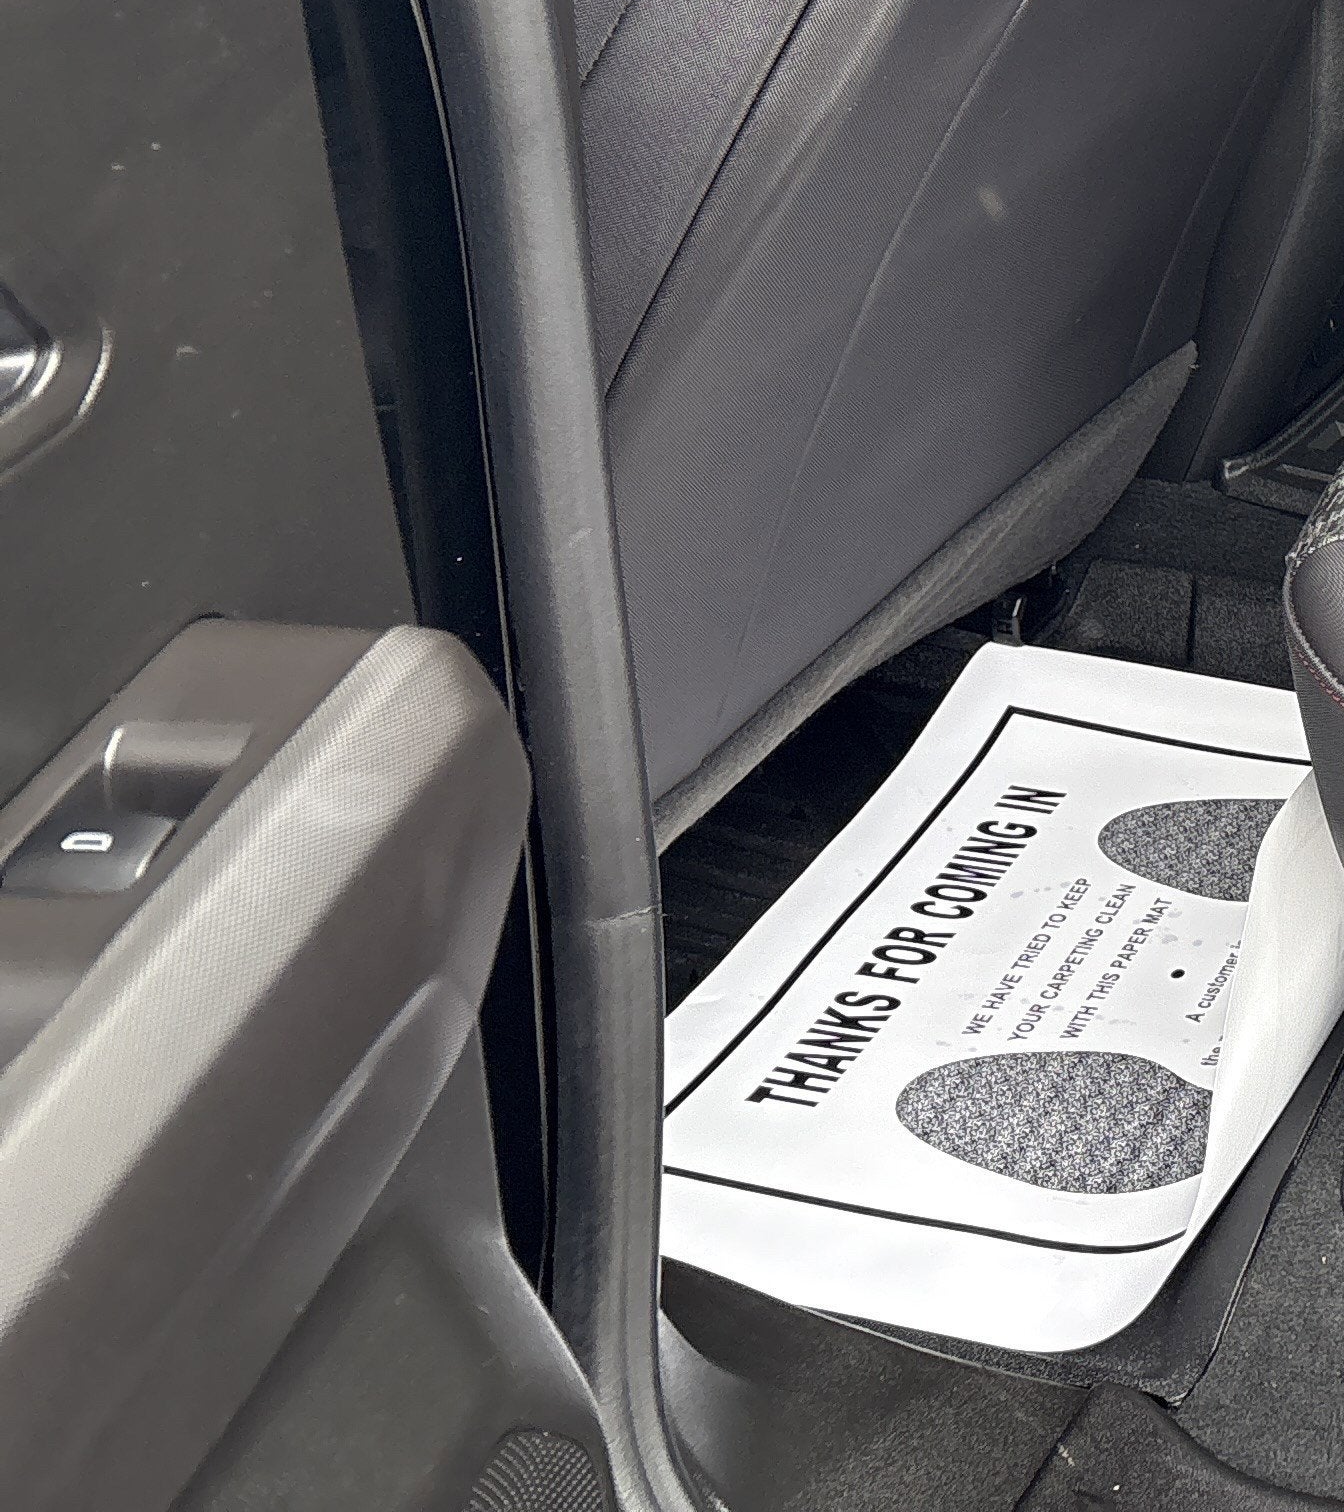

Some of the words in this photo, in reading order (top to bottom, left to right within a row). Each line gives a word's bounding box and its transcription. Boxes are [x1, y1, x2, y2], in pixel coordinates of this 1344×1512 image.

[745, 991, 901, 1107] THANKS
[855, 926, 957, 984] FOR
[910, 820, 1037, 919] COMING
[994, 785, 1068, 815] IN
[961, 1013, 993, 1035] WE
[981, 974, 1023, 1009] HAVE
[1011, 933, 1051, 969] TRIED
[1041, 913, 1067, 929] TO
[1057, 877, 1092, 910] KEEP
[1007, 1003, 1051, 1041] YOUR
[1040, 928, 1104, 1000] CARPETING
[1095, 883, 1136, 924] CLEAN
[1059, 1005, 1098, 1039] WITH
[1086, 972, 1121, 1000] THIS
[1110, 927, 1154, 969] PAPER
[1141, 897, 1172, 924] MAT
[1185, 1012, 1205, 1023] A
[1198, 952, 1238, 1009] customer
